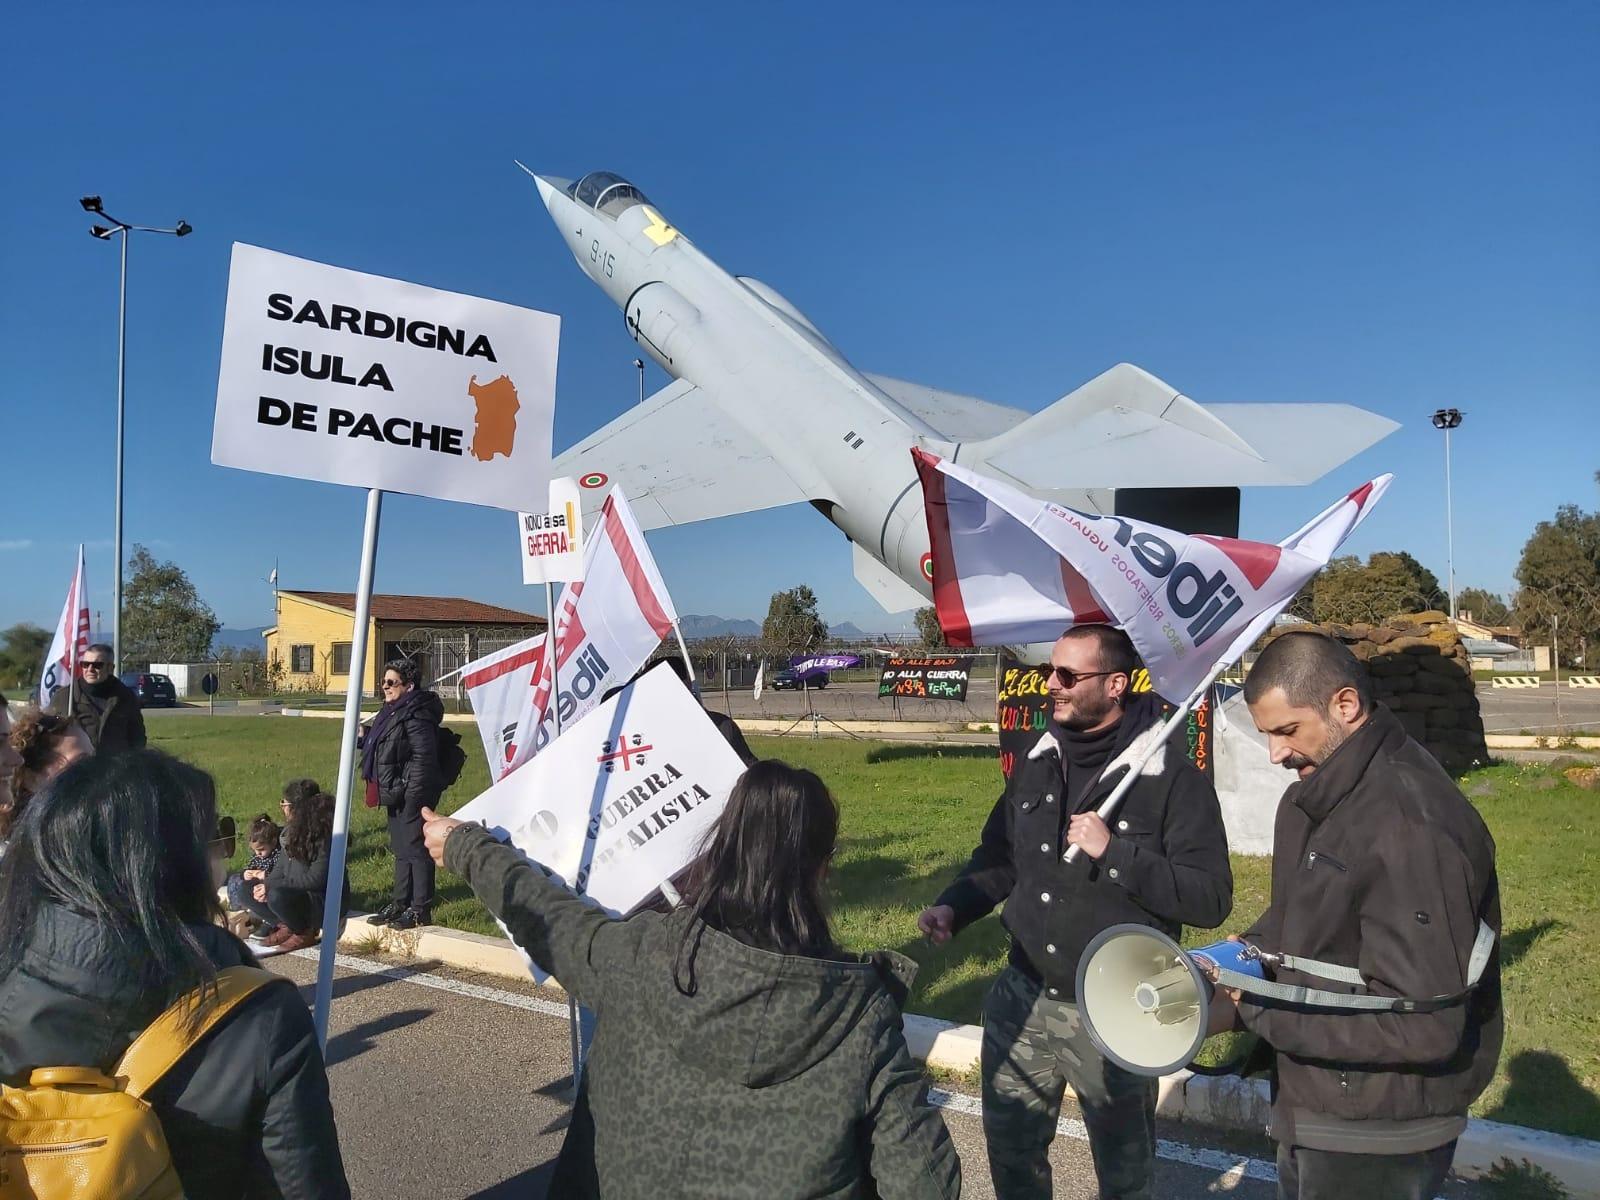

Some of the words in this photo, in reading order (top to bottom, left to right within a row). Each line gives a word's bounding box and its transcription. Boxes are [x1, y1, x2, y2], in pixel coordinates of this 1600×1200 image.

[590, 239, 616, 278] 9-15
[266, 293, 498, 363] SARDIGNA
[262, 344, 394, 392] ISULA
[257, 396, 318, 433] DE
[327, 408, 464, 456] PACHE
[552, 514, 566, 528] sa
[883, 671, 896, 680] NO
[897, 671, 922, 679] ALLA
[926, 670, 967, 680] GUERRA
[933, 658, 957, 666] BASI
[928, 681, 961, 697] TERRA
